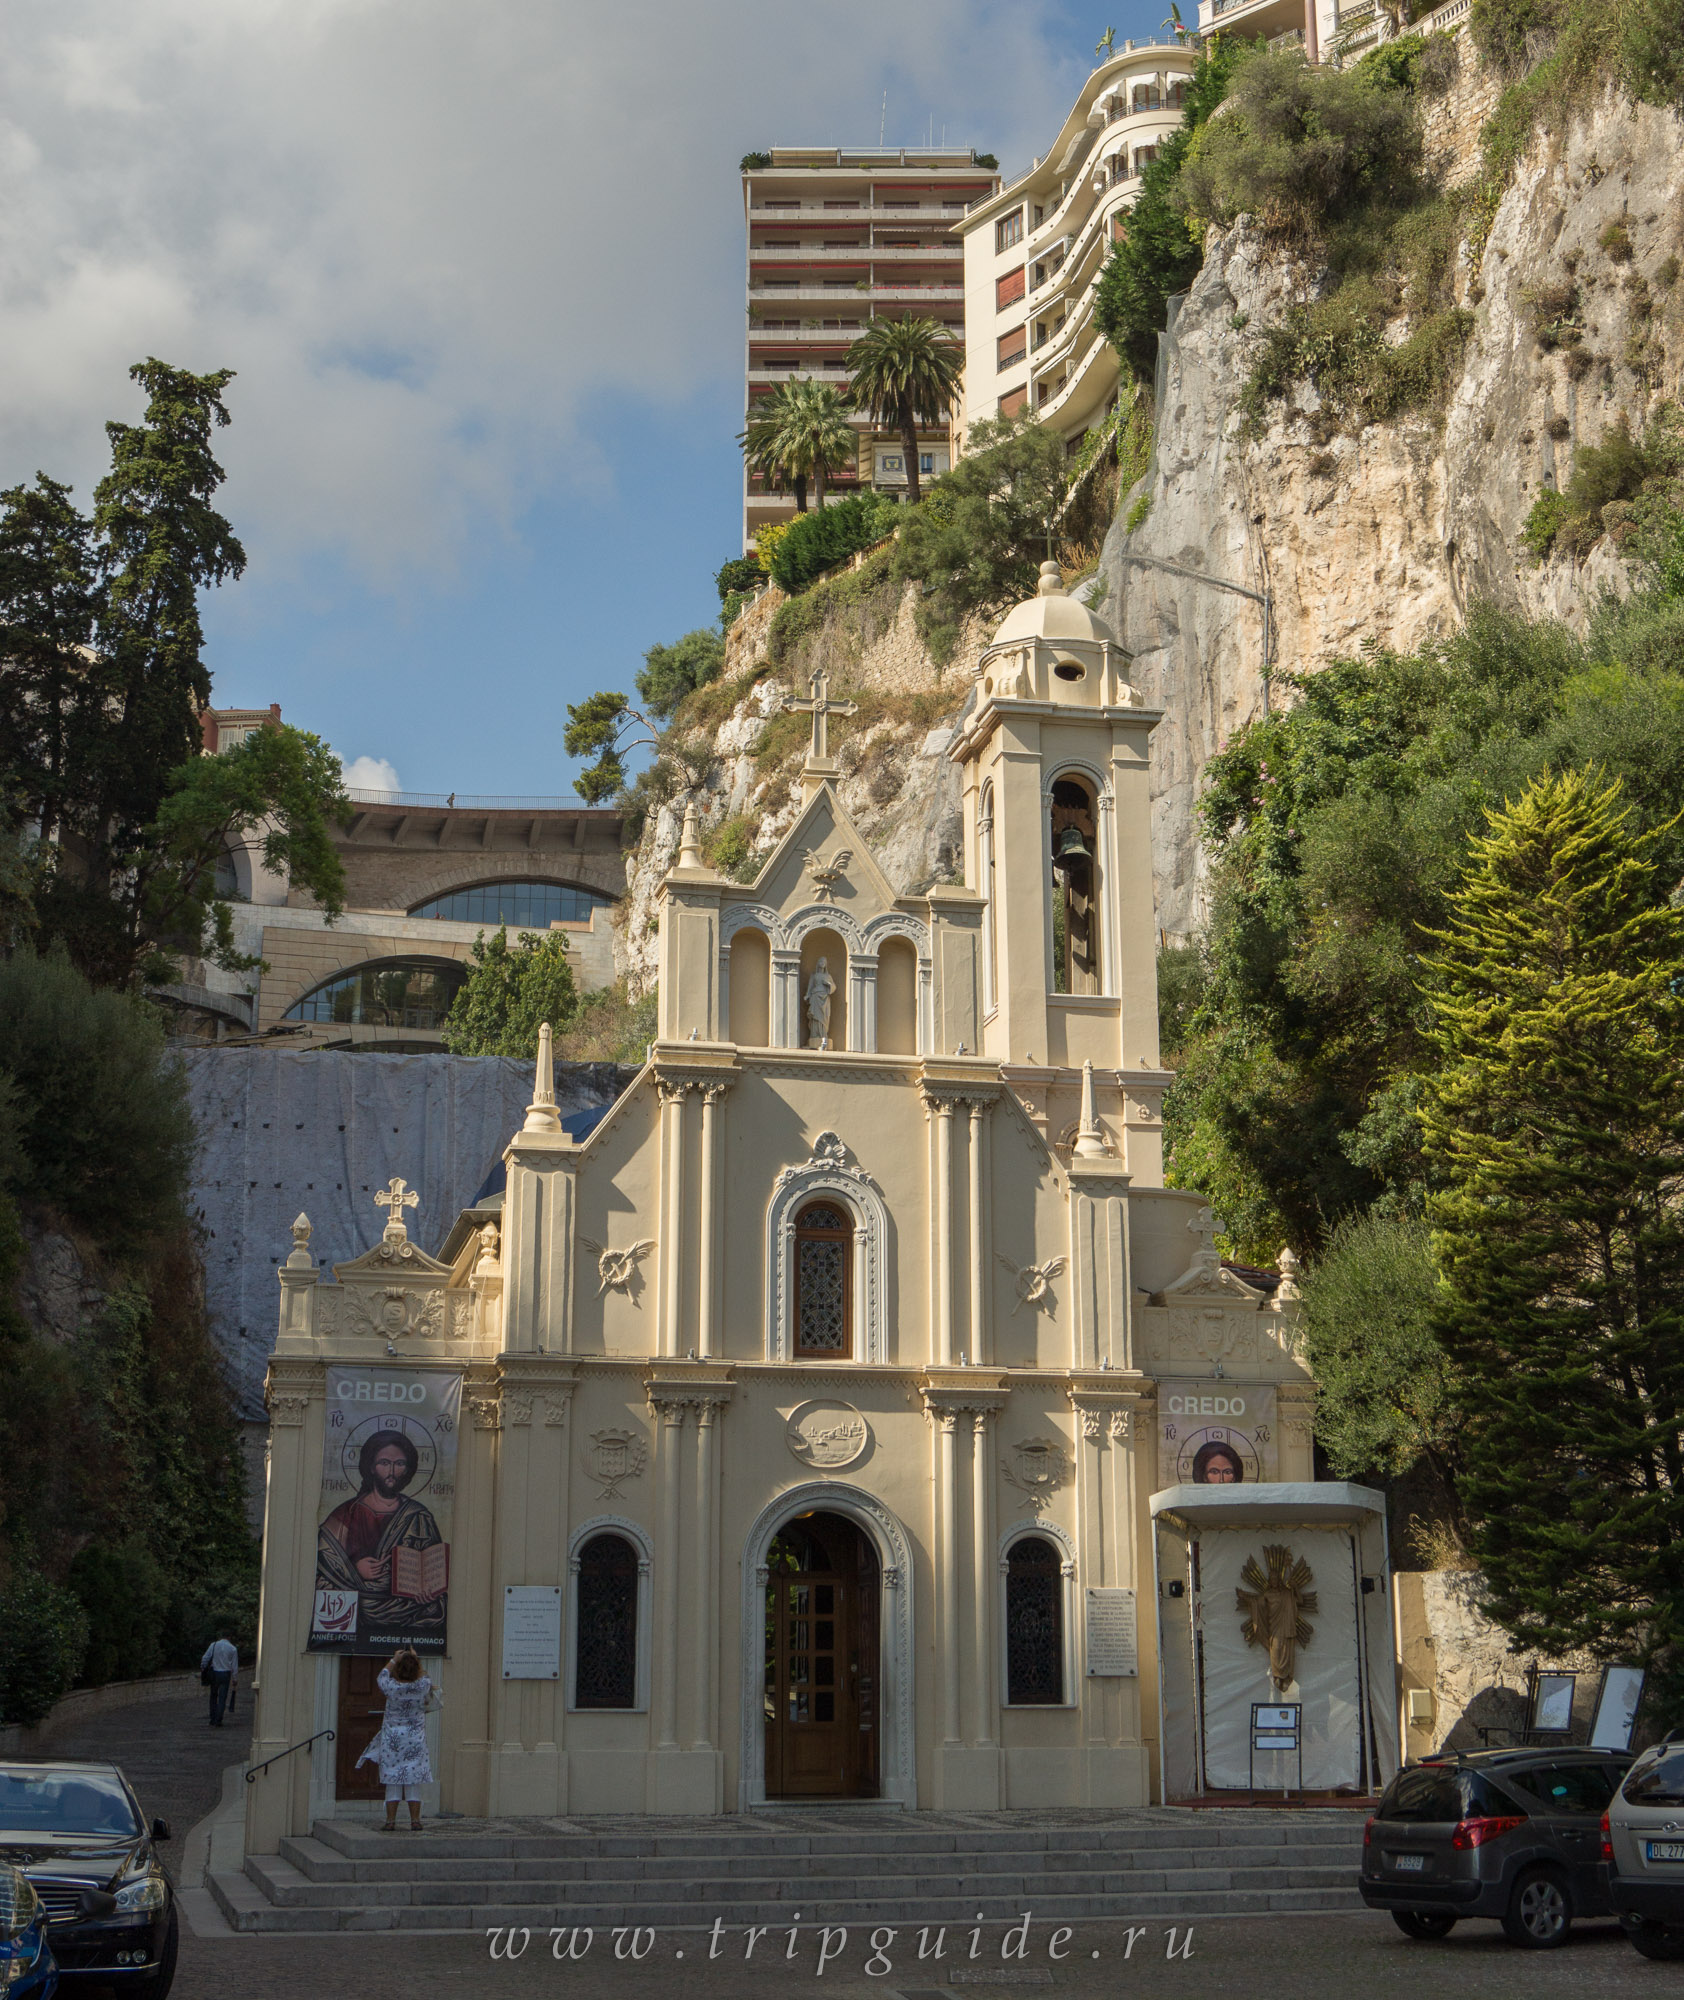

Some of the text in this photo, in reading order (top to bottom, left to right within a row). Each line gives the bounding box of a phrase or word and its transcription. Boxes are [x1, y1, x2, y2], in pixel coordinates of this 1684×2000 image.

[336, 1380, 427, 1404] CREDO
[1168, 1395, 1246, 1416] CREDO
[413, 1637, 445, 1646] MONACO
